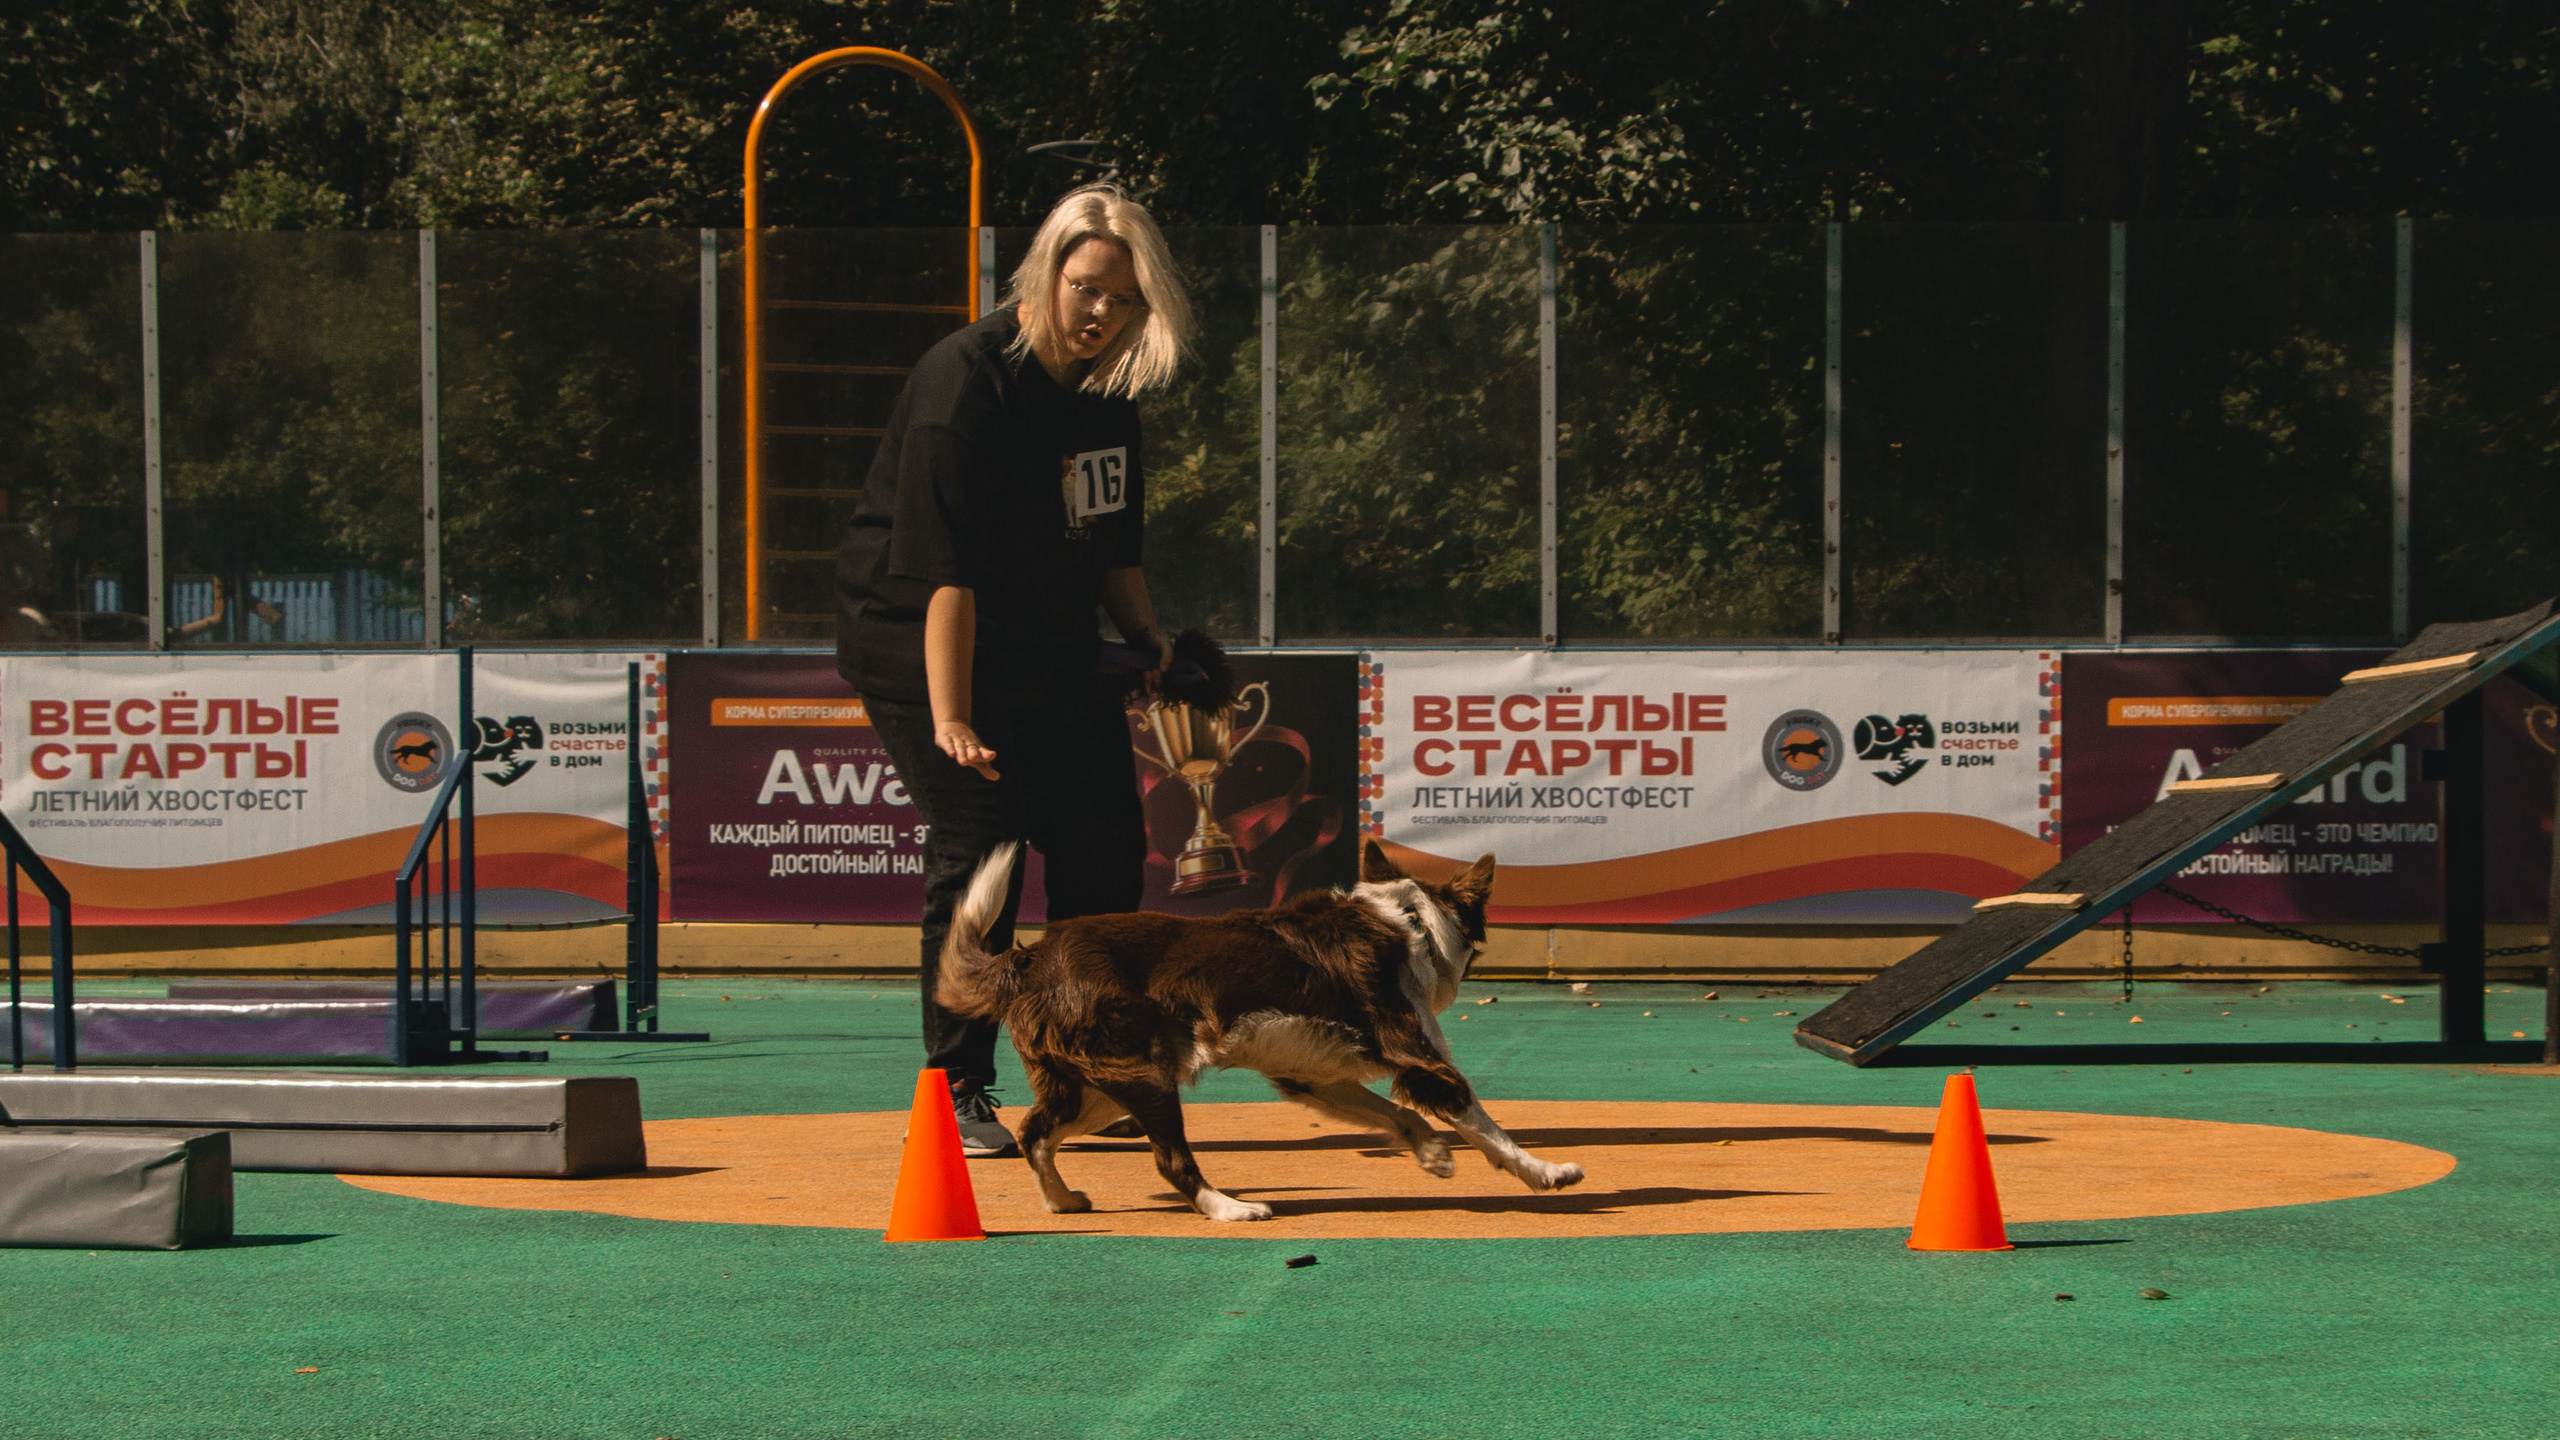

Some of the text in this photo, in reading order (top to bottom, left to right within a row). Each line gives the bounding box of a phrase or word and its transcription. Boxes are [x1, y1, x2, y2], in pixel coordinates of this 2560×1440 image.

[1081, 455, 1121, 509] 16
[29, 691, 339, 736] ВЕСЁЛЫЕ
[725, 706, 863, 719] КОРМА СУПЕРПРЕМИУМ
[1413, 687, 1727, 732] ВЕСЁЛЫЕ
[2122, 704, 2163, 718] КОРМА
[550, 723, 626, 735] возьми
[1941, 721, 2019, 734] возьми
[550, 738, 626, 750] счастье
[1941, 738, 2019, 750] счастье
[813, 748, 866, 756] QUALITY
[1413, 736, 1694, 776] СТАРТЫ
[30, 740, 307, 780] СТАРТЫ
[550, 756, 602, 768] в дом
[1941, 755, 1994, 767] в дом
[392, 773, 417, 787] DOG
[1781, 771, 1805, 785] DOG
[28, 786, 308, 812] ЛЕТНИЙ ХВОСТФЕСТ
[1412, 781, 1695, 809] ЛЕТНИЙ ХВОСТФЕСТ
[1411, 816, 1608, 826] ФЕСТИВАЛЬ БЛАГОПОЛУЧИЯ ПИТОМЦЕВ
[710, 820, 799, 847] КАЖДЫЙ
[804, 824, 895, 847] ПИТОМЕЦ
[914, 825, 931, 844] Э
[2316, 823, 2350, 843] ЭТО
[2356, 823, 2438, 843] ЧЕМПИО
[770, 850, 888, 877] ДОСТОЙНЫЙ
[2294, 853, 2393, 876] НАГРАДЫ!
